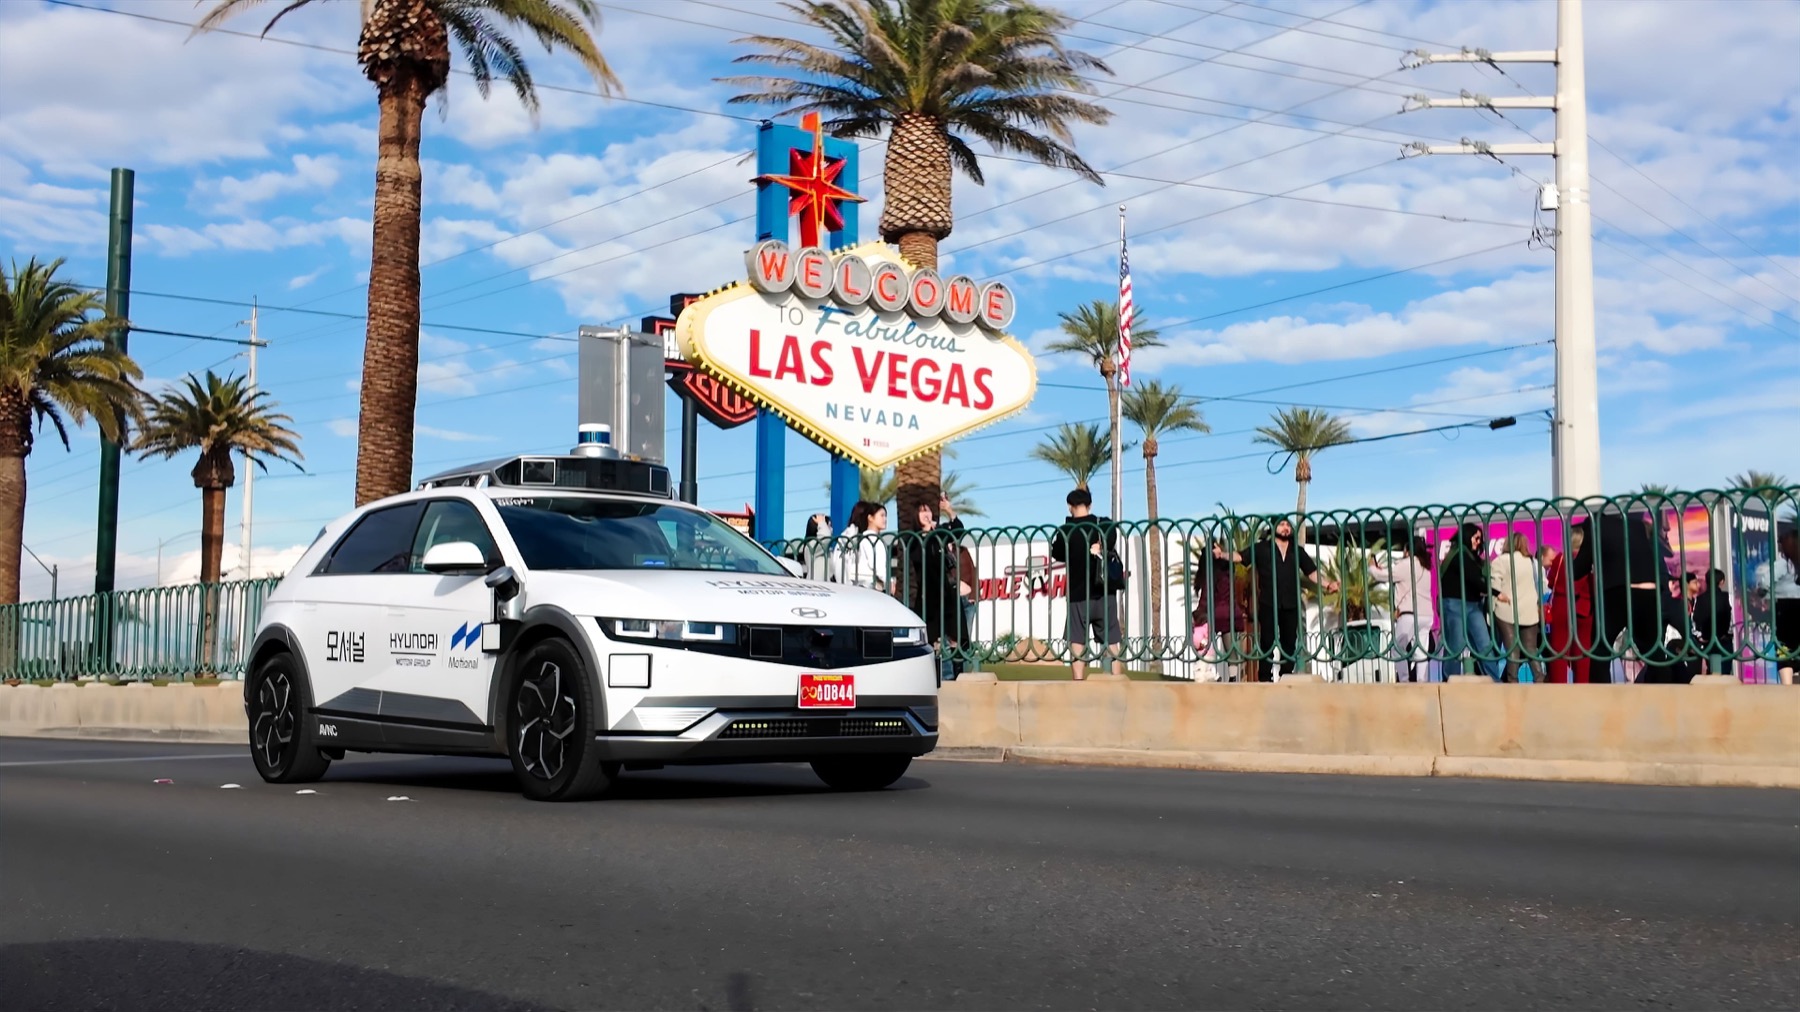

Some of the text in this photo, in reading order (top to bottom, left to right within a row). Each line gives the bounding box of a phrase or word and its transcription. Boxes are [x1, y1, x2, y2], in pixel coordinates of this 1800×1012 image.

[760, 250, 1004, 320] WELCOME
[775, 304, 966, 353] TO Fabulous
[749, 329, 834, 387] LAS
[851, 345, 994, 410] VEGAS
[826, 402, 919, 430] NEVADA
[327, 631, 365, 663] 모셔널
[390, 632, 438, 650] HYUNDAI
[448, 656, 479, 670] Motional
